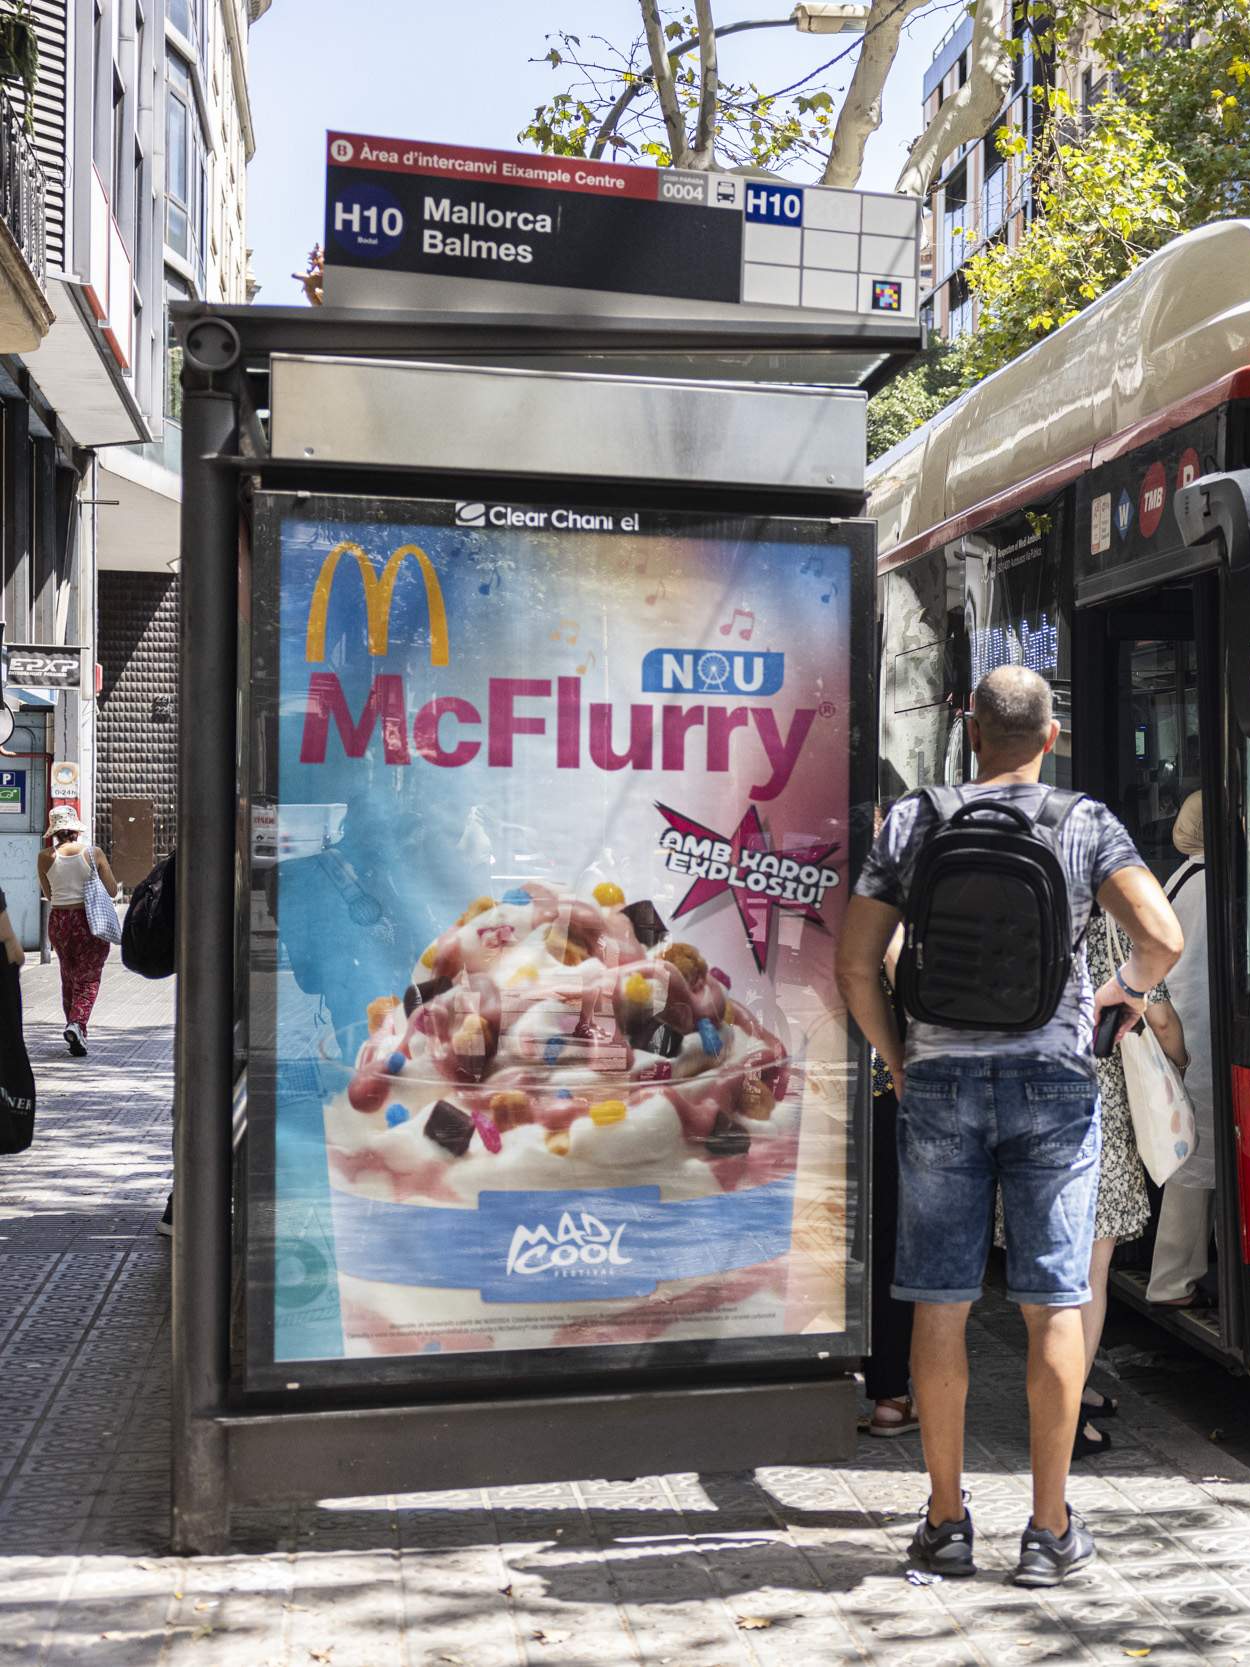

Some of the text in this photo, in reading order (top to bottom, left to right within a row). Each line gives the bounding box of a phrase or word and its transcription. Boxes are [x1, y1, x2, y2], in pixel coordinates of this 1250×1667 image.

[360, 142, 398, 164] Àrea
[502, 163, 571, 184] Eixample
[575, 171, 625, 189] Centre
[663, 183, 704, 201] 0004
[747, 189, 801, 219] H10
[334, 202, 404, 237] H10
[424, 196, 552, 233] Mallorca
[422, 229, 534, 263] Balmes
[489, 506, 548, 528] Clear
[1144, 487, 1164, 513] TMB
[2, 773, 12, 785] P
[659, 829, 840, 888] AMB XAROP
[667, 853, 825, 909] EXPLOSIU!
[506, 1211, 612, 1276] MAD
[513, 1222, 633, 1274] COOL
